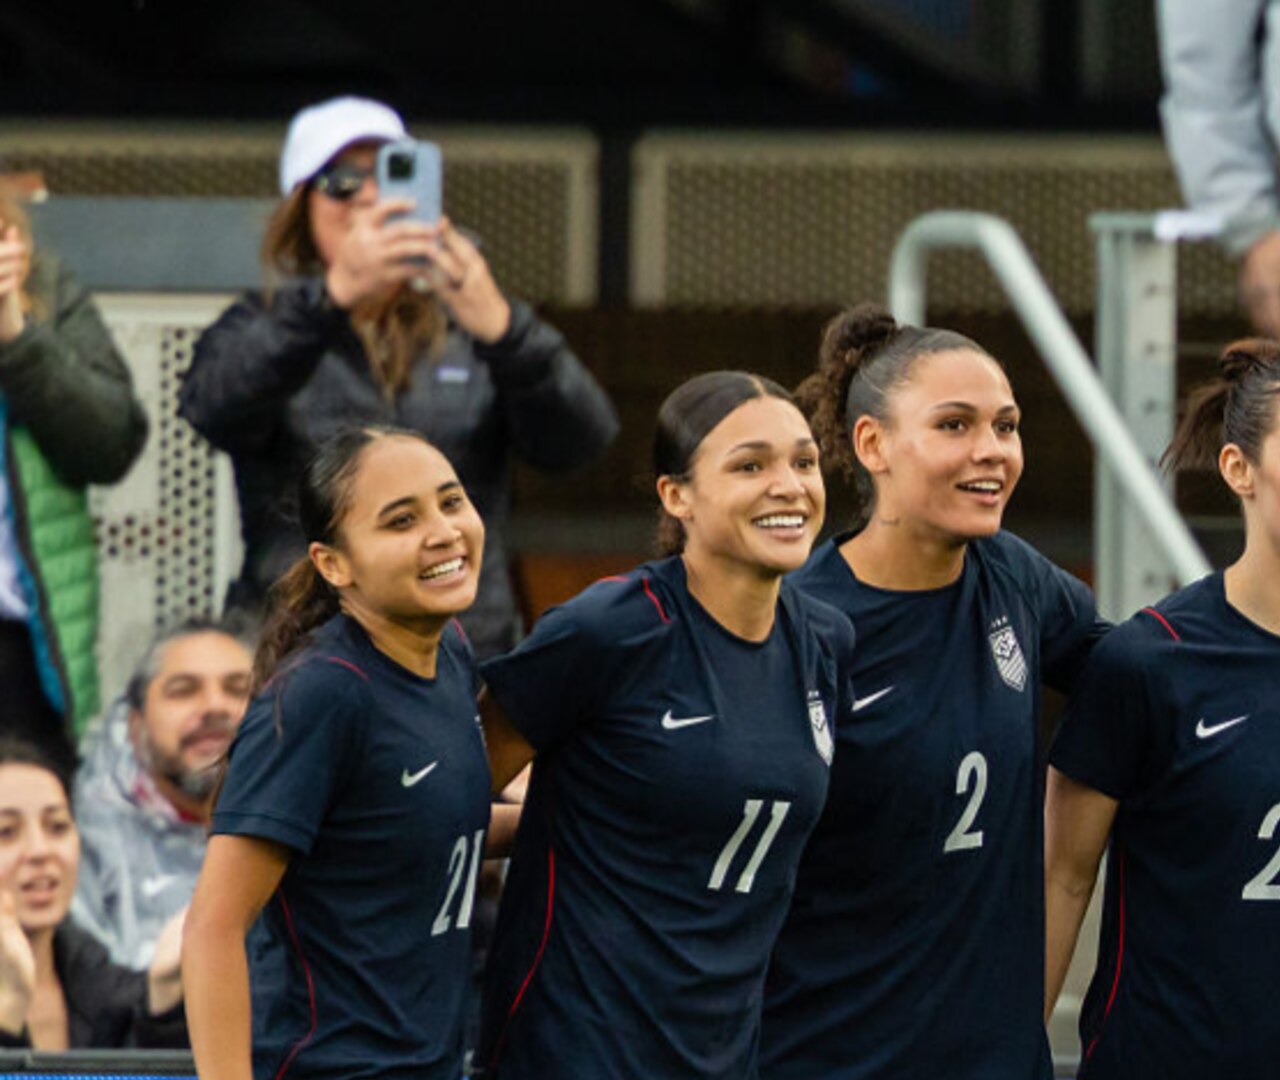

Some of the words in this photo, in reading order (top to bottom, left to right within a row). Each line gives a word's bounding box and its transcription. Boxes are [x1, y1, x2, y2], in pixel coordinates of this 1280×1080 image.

[707, 799, 791, 894] 11
[944, 751, 988, 852] 2
[430, 829, 484, 936] 21
